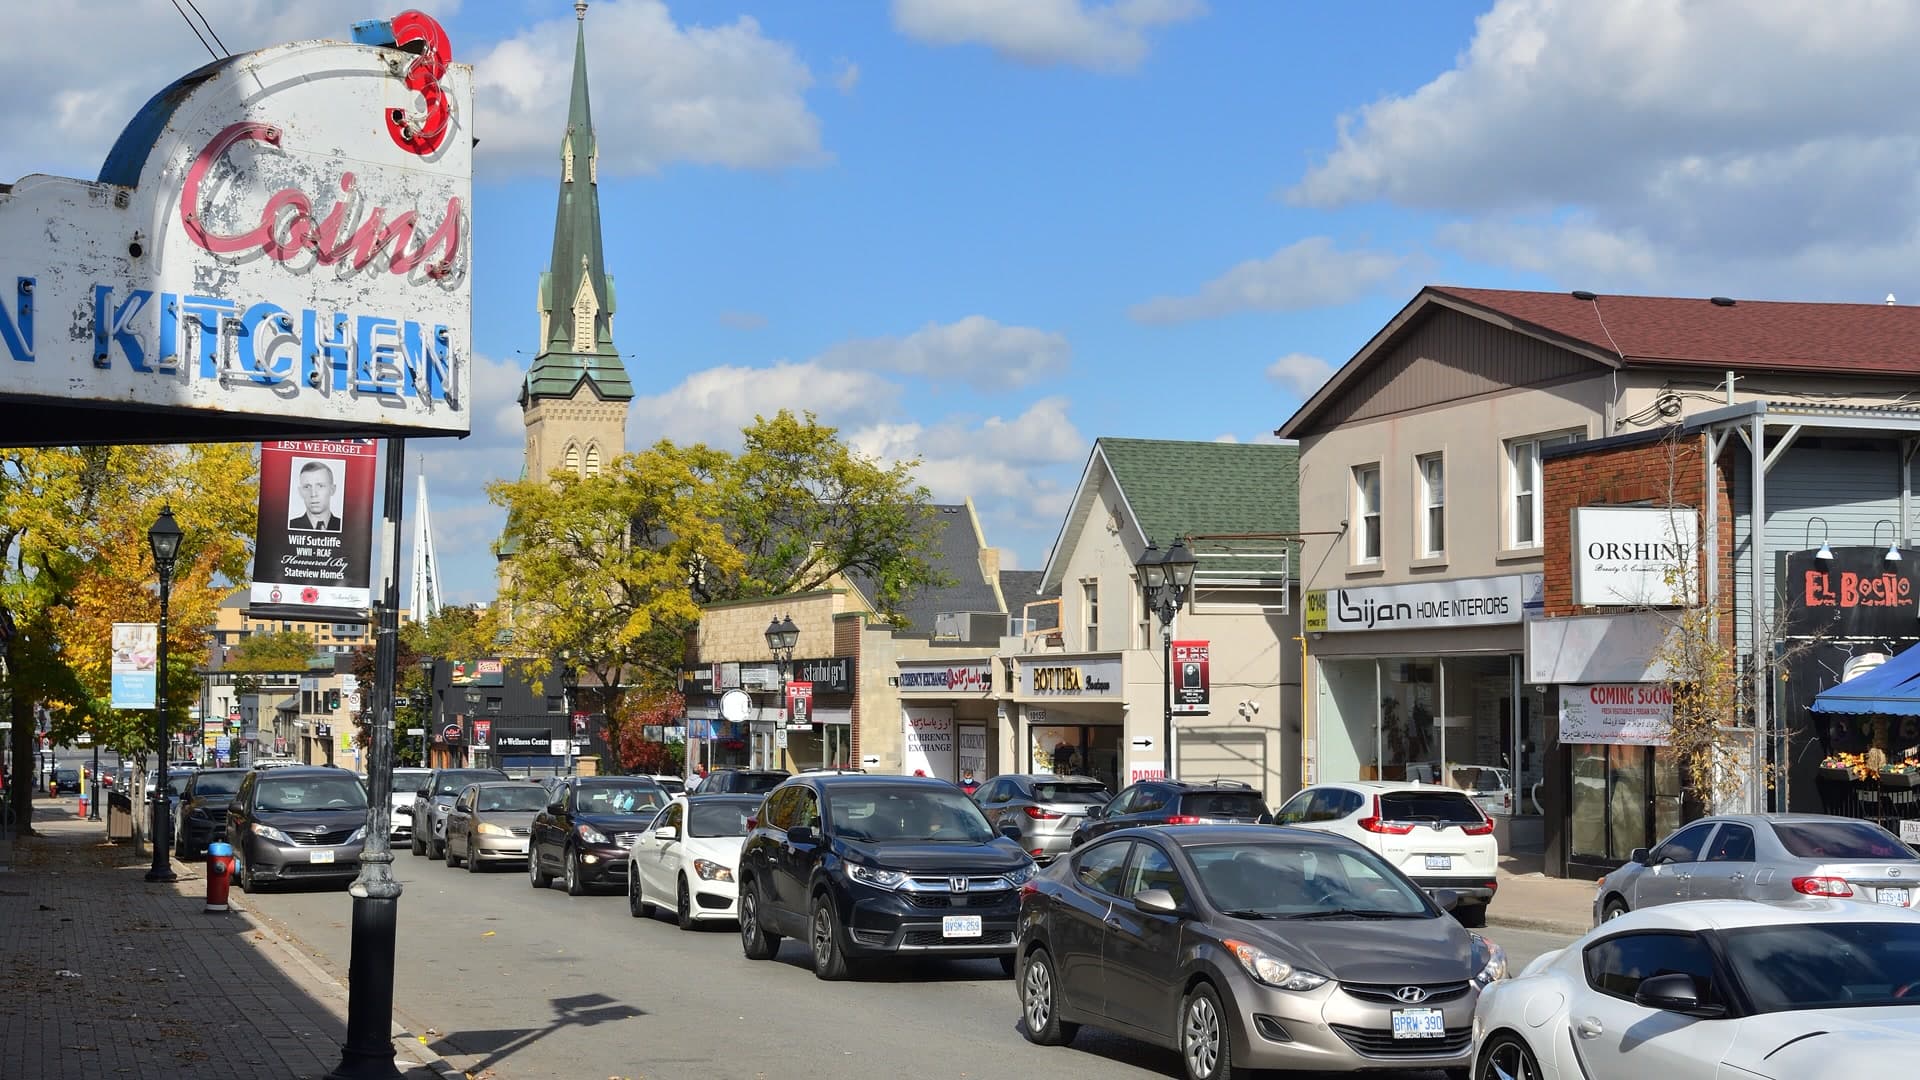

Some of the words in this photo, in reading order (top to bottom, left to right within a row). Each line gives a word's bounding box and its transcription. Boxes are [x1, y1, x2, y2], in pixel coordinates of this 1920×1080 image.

[384, 9, 452, 156] 3
[180, 121, 464, 281] Coins
[94, 284, 459, 406] KITCHEN
[277, 441, 301, 450] LEST
[304, 442, 322, 452] WE
[322, 444, 363, 454] FORGET
[288, 534, 306, 546] Wilf
[306, 535, 342, 547] Sutcliffe
[296, 547, 313, 556] WWII
[316, 548, 332, 557] RCAF
[280, 554, 330, 566] Honoured
[330, 557, 348, 573] By
[284, 567, 320, 579] Stateview
[320, 567, 345, 580] Homes
[1805, 570, 1836, 607] EL
[1416, 601, 1449, 618] HOME
[1451, 597, 1509, 617] INTERIORS
[803, 659, 831, 682] istanbul
[831, 658, 847, 687] grill
[900, 672, 923, 687] CURRENCY
[923, 671, 948, 687] EXCHANGE
[1590, 687, 1634, 705] COMING
[1637, 686, 1673, 705] SOON
[507, 737, 531, 746] Wellness
[531, 737, 549, 746] Centre
[908, 733, 952, 742] CURRENCY
[960, 733, 985, 749] CURRENCY
[908, 743, 952, 752] EXCHANGE
[1132, 769, 1166, 784] PARKIN
